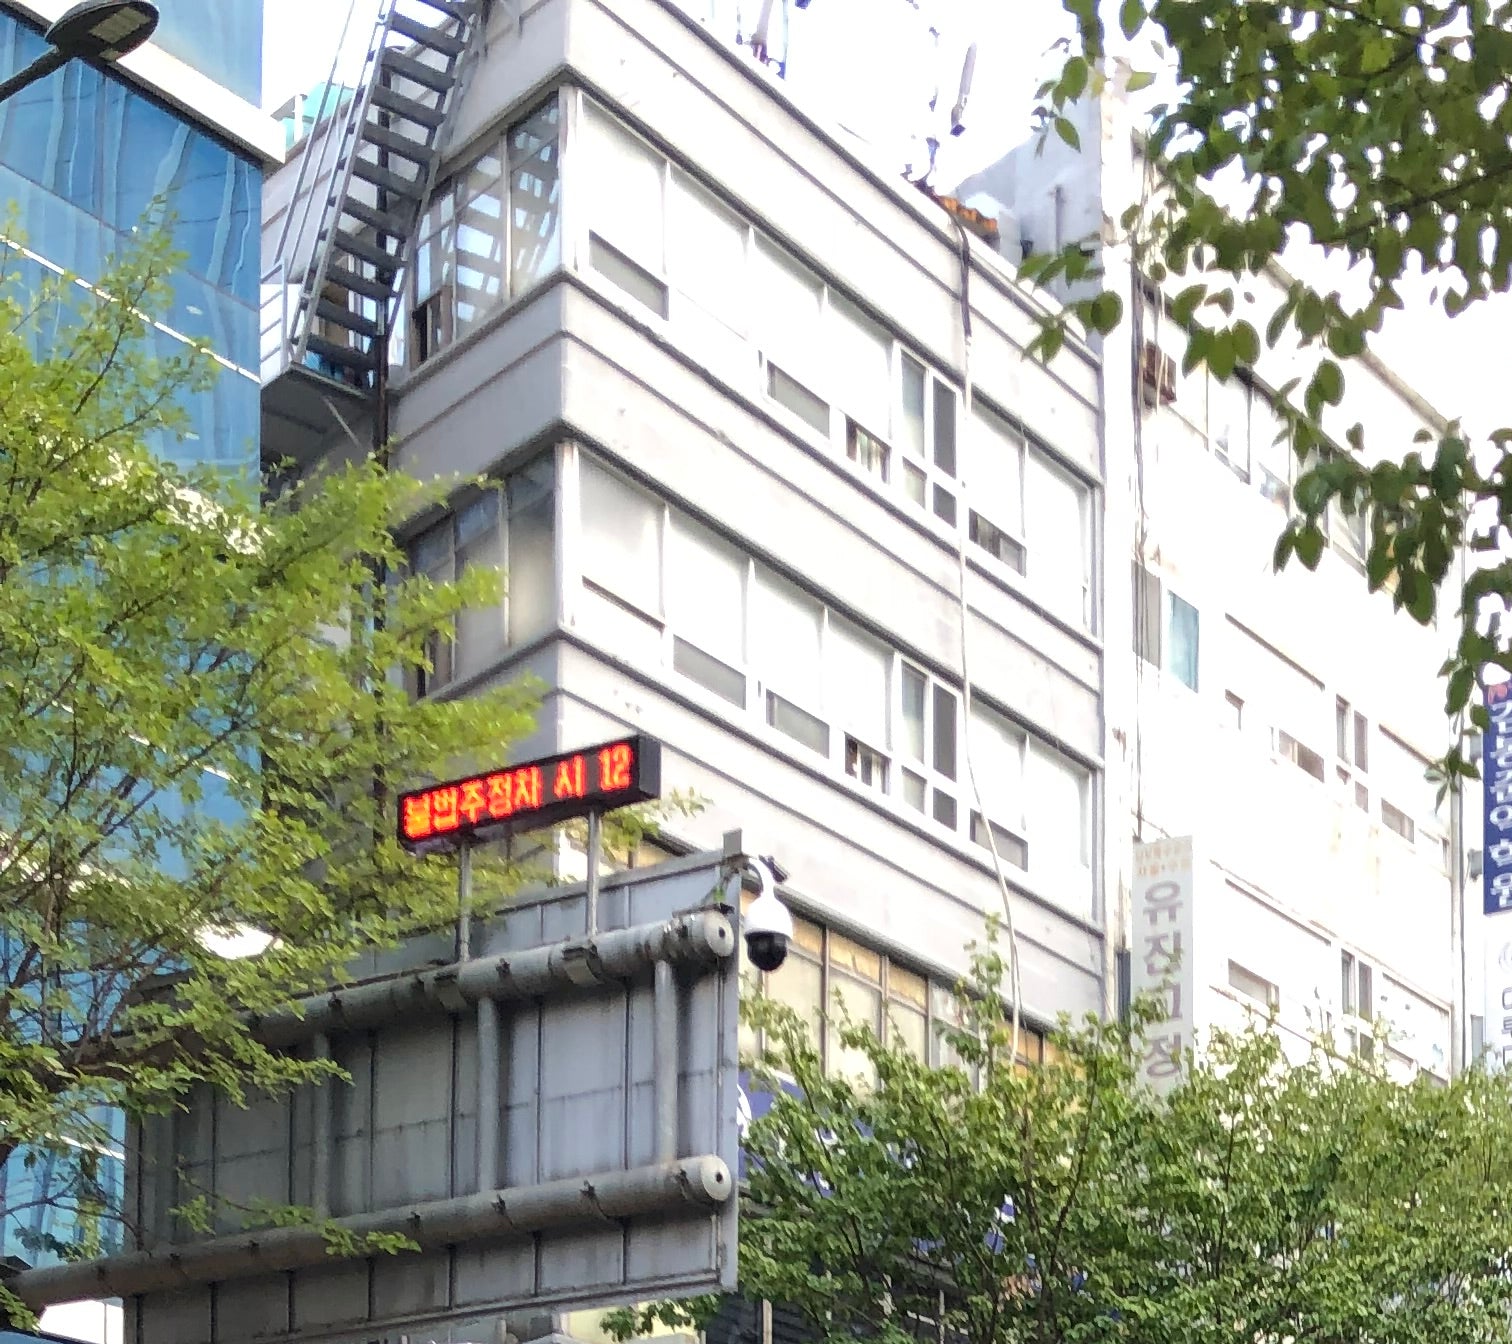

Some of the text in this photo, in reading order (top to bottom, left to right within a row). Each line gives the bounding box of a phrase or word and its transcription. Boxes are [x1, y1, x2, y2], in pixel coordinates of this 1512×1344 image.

[403, 742, 634, 839] 불법주정차 시 12
